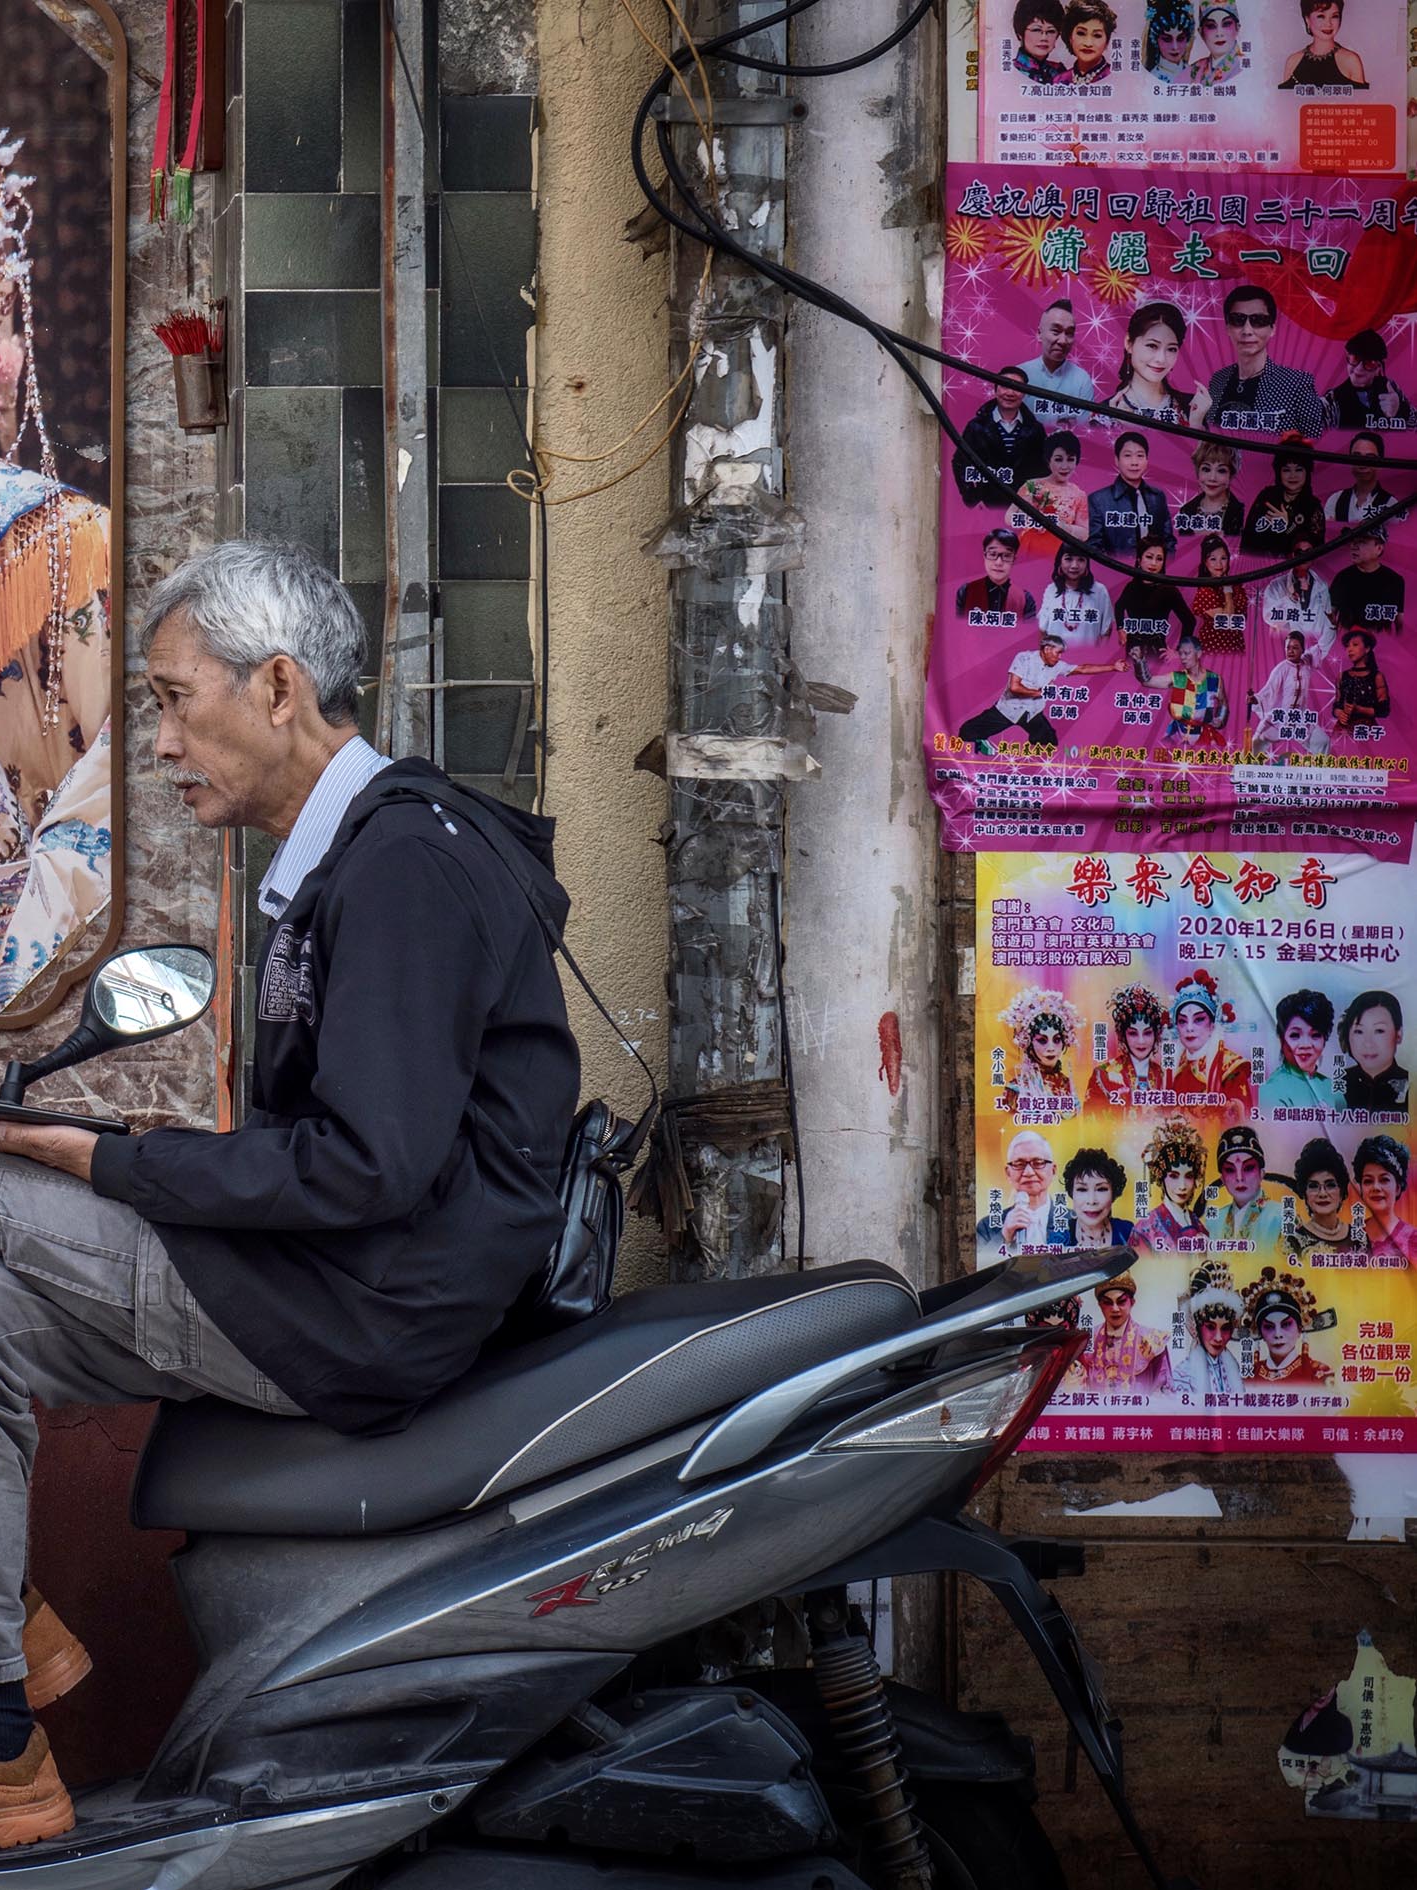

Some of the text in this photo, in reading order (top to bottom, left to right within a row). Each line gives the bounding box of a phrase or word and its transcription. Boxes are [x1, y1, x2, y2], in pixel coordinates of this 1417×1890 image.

[1040, 227, 1350, 281] 瀟灑走一回
[1365, 413, 1407, 430] Lam
[965, 466, 1013, 484] 陳鏡
[1106, 511, 1153, 527] 陳建中
[1255, 517, 1286, 533] 少珍
[968, 610, 1018, 628] 陳炳慶
[1270, 607, 1317, 622] 加路士
[1365, 605, 1399, 621] 漢哥
[1124, 619, 1170, 635] 郭鳳玲
[1214, 615, 1246, 630] 雯雯
[1042, 685, 1089, 702] 楊有成
[1114, 692, 1163, 709] 潘仲君
[1050, 706, 1080, 720] 師傅
[1122, 710, 1153, 725] 師傅
[1279, 727, 1309, 741] 師傅
[1353, 725, 1386, 741] 燕子
[998, 741, 1057, 758] 澳門基金會
[1089, 746, 1149, 760] 澳門市政署
[1172, 750, 1268, 766] 澳門霍英東基金會
[1290, 754, 1409, 773] 澳門博彩股份有限公司
[1257, 772, 1274, 780] 2020
[992, 917, 1114, 932] 澳門基金會 文化局
[992, 934, 1155, 949] 旅遊局 澳門霍英東基金會
[992, 952, 1131, 967] 澳門博彩股份有限公司
[1277, 943, 1400, 962] 金碧文娛中心
[992, 1047, 1005, 1086] 余小鳳
[1333, 1055, 1346, 1093] 馬少英
[1352, 1203, 1366, 1241] 余卓玲
[1358, 1321, 1394, 1339] 完場
[1341, 1343, 1412, 1361] 各位觀眾
[1341, 1366, 1412, 1382] 禮物一份
[1362, 1676, 1375, 1704] 司儀
